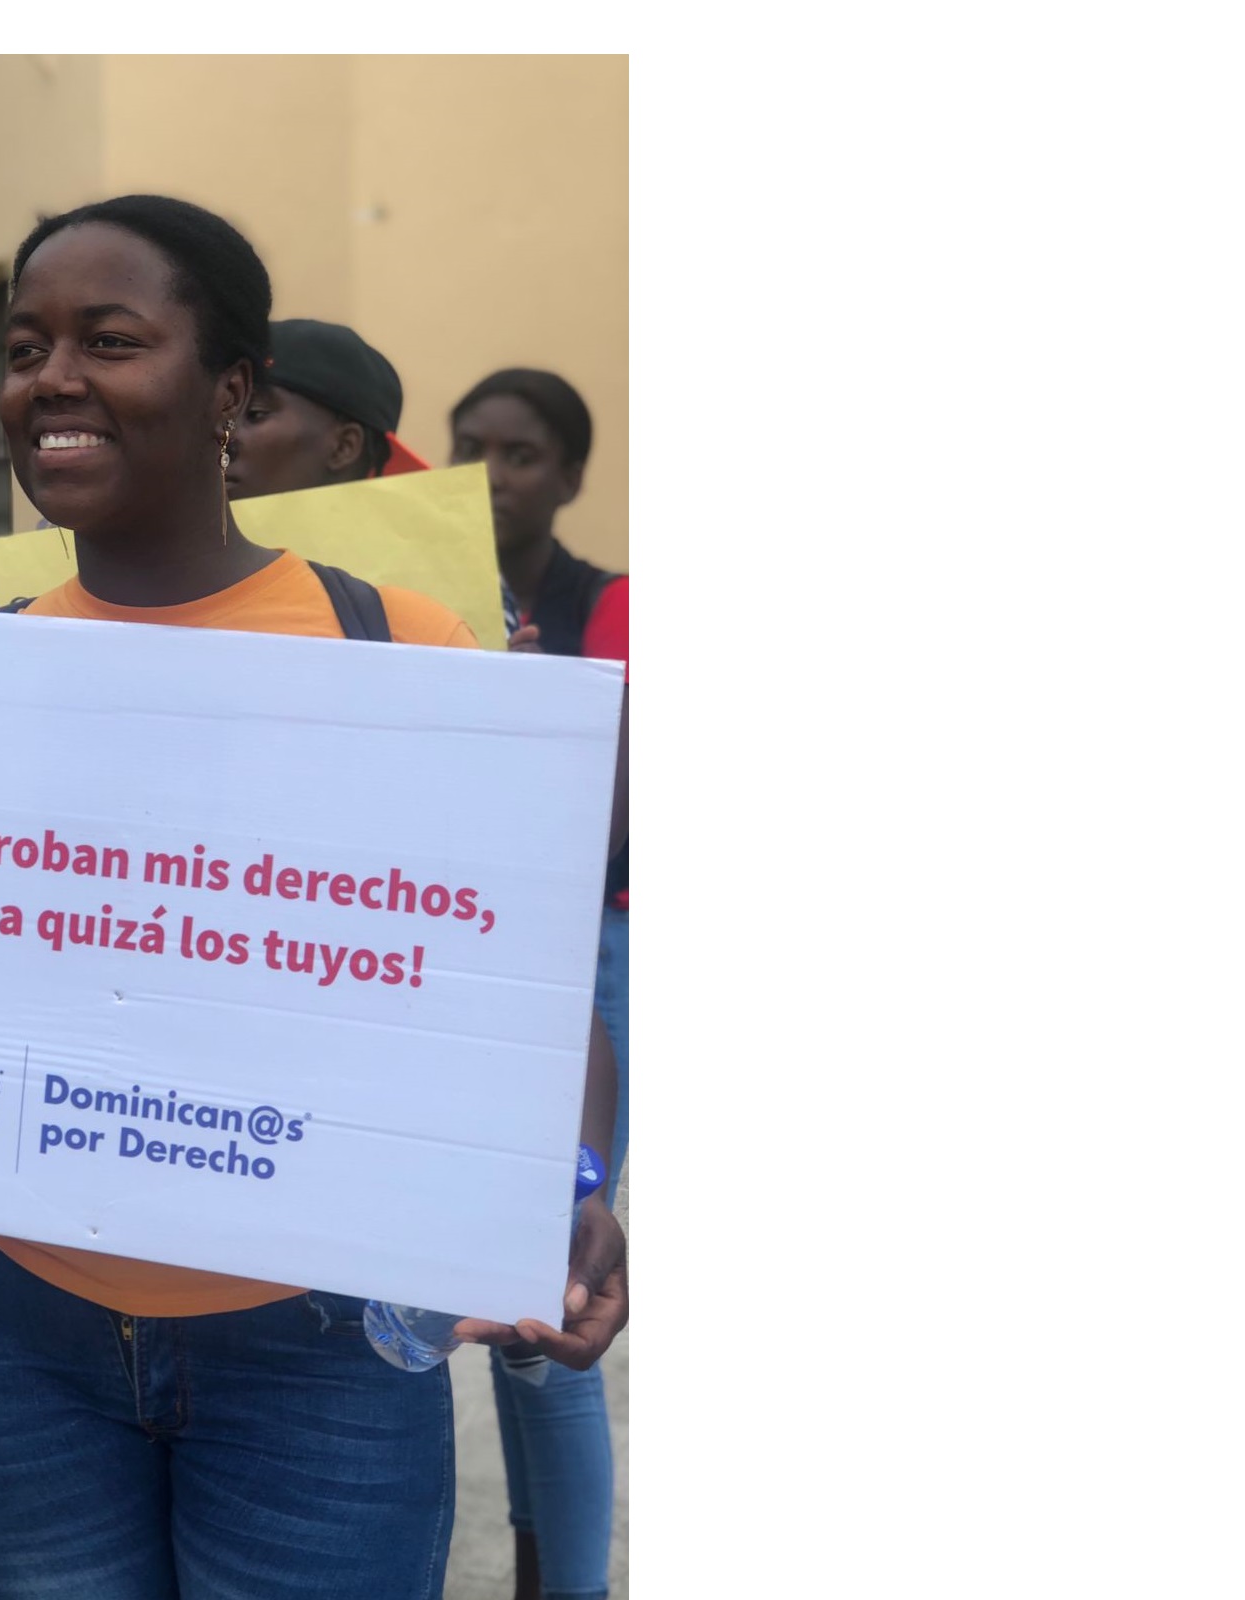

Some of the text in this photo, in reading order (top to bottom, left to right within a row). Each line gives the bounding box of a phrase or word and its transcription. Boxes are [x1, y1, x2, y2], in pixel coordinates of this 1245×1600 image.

[144, 844, 230, 891] mis
[244, 854, 496, 934] derechos,
[37, 906, 166, 955] quizá
[180, 916, 250, 965] los
[263, 930, 425, 988] tuyos!
[39, 1122, 276, 1180] por Derecho
